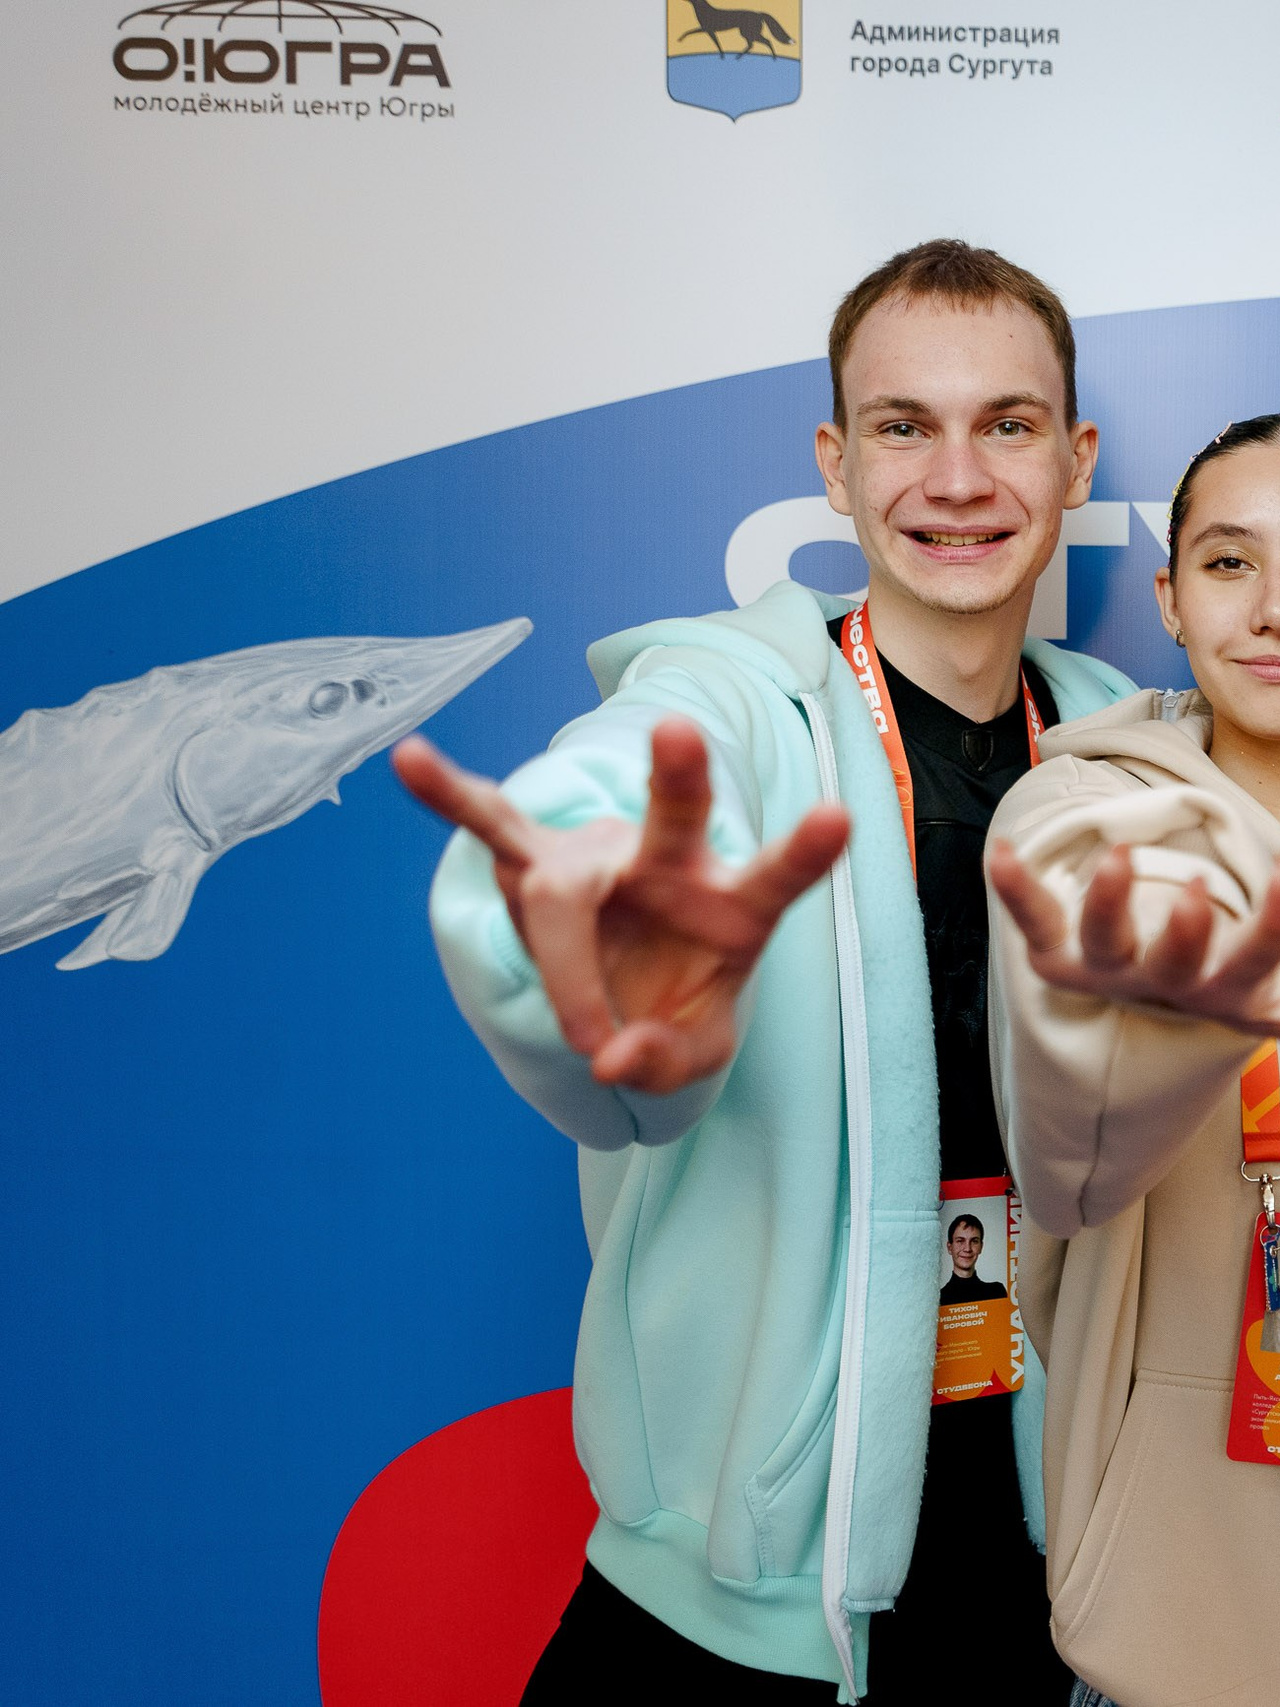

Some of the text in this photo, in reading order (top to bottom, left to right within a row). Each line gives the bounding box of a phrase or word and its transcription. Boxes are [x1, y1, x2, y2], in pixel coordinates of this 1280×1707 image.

[850, 19, 1060, 46] Администрация
[850, 53, 1053, 79] города Сургута
[113, 91, 455, 122] молодёжный центр Югры
[940, 1311, 988, 1322] ИВАНОВИЧ
[949, 1305, 979, 1314] ТИХОН
[943, 1318, 985, 1330] БОРОВОЙ
[936, 1380, 993, 1395] СТУДВЕСНА
